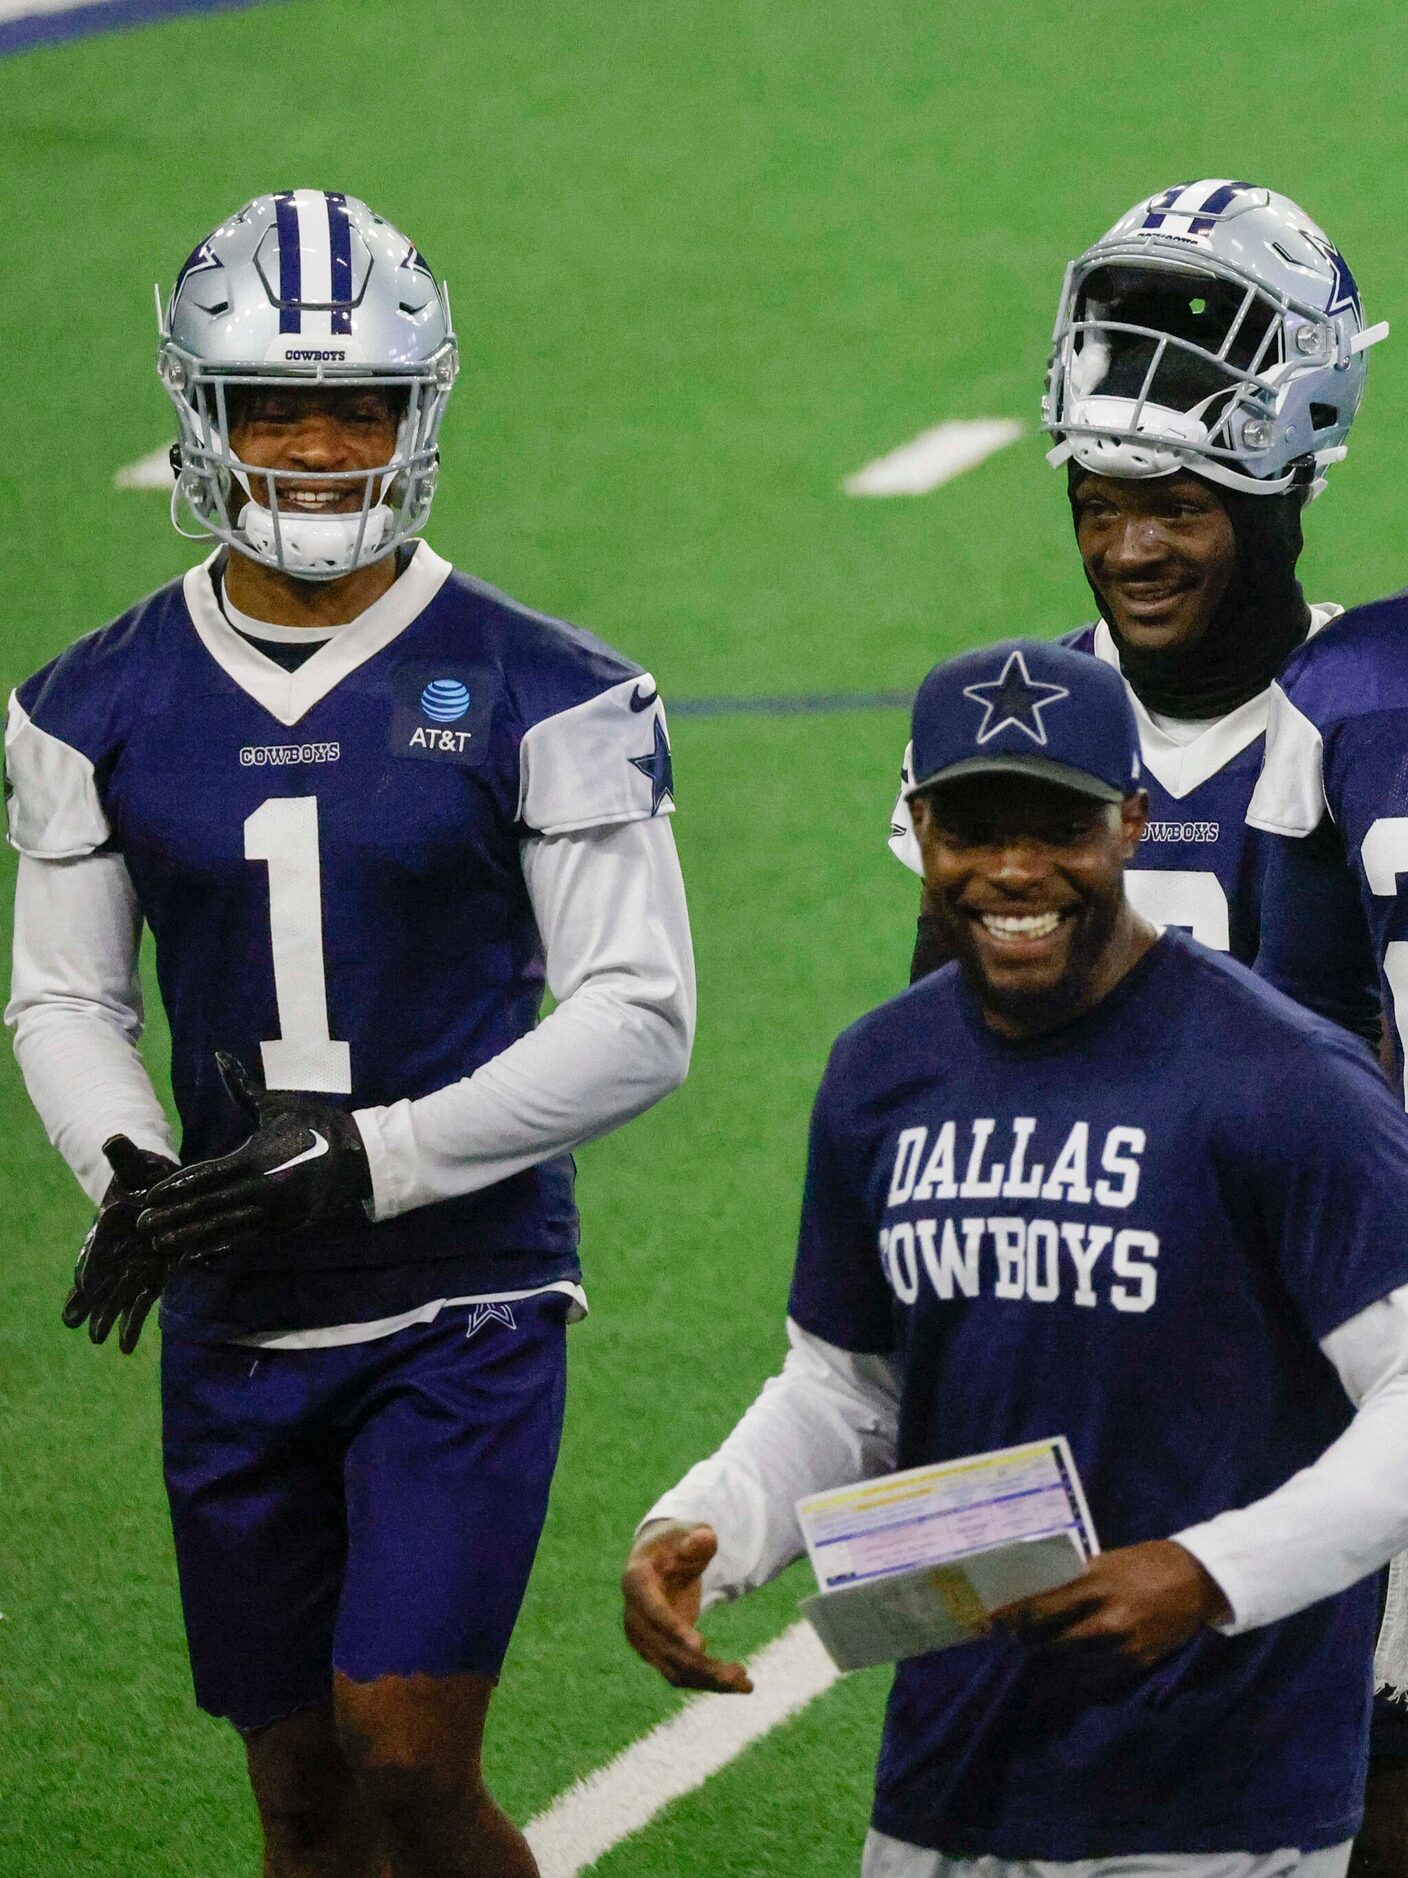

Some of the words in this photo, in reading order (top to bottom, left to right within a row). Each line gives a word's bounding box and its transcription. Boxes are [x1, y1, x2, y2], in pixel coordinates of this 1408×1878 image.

[285, 349, 346, 361] COWBOYS
[408, 727, 472, 753] AT&T
[239, 741, 341, 766] COWBOYS
[1138, 822, 1220, 842] OWBOYS
[243, 795, 352, 1094] 1
[886, 1116, 1147, 1209] DALLAS
